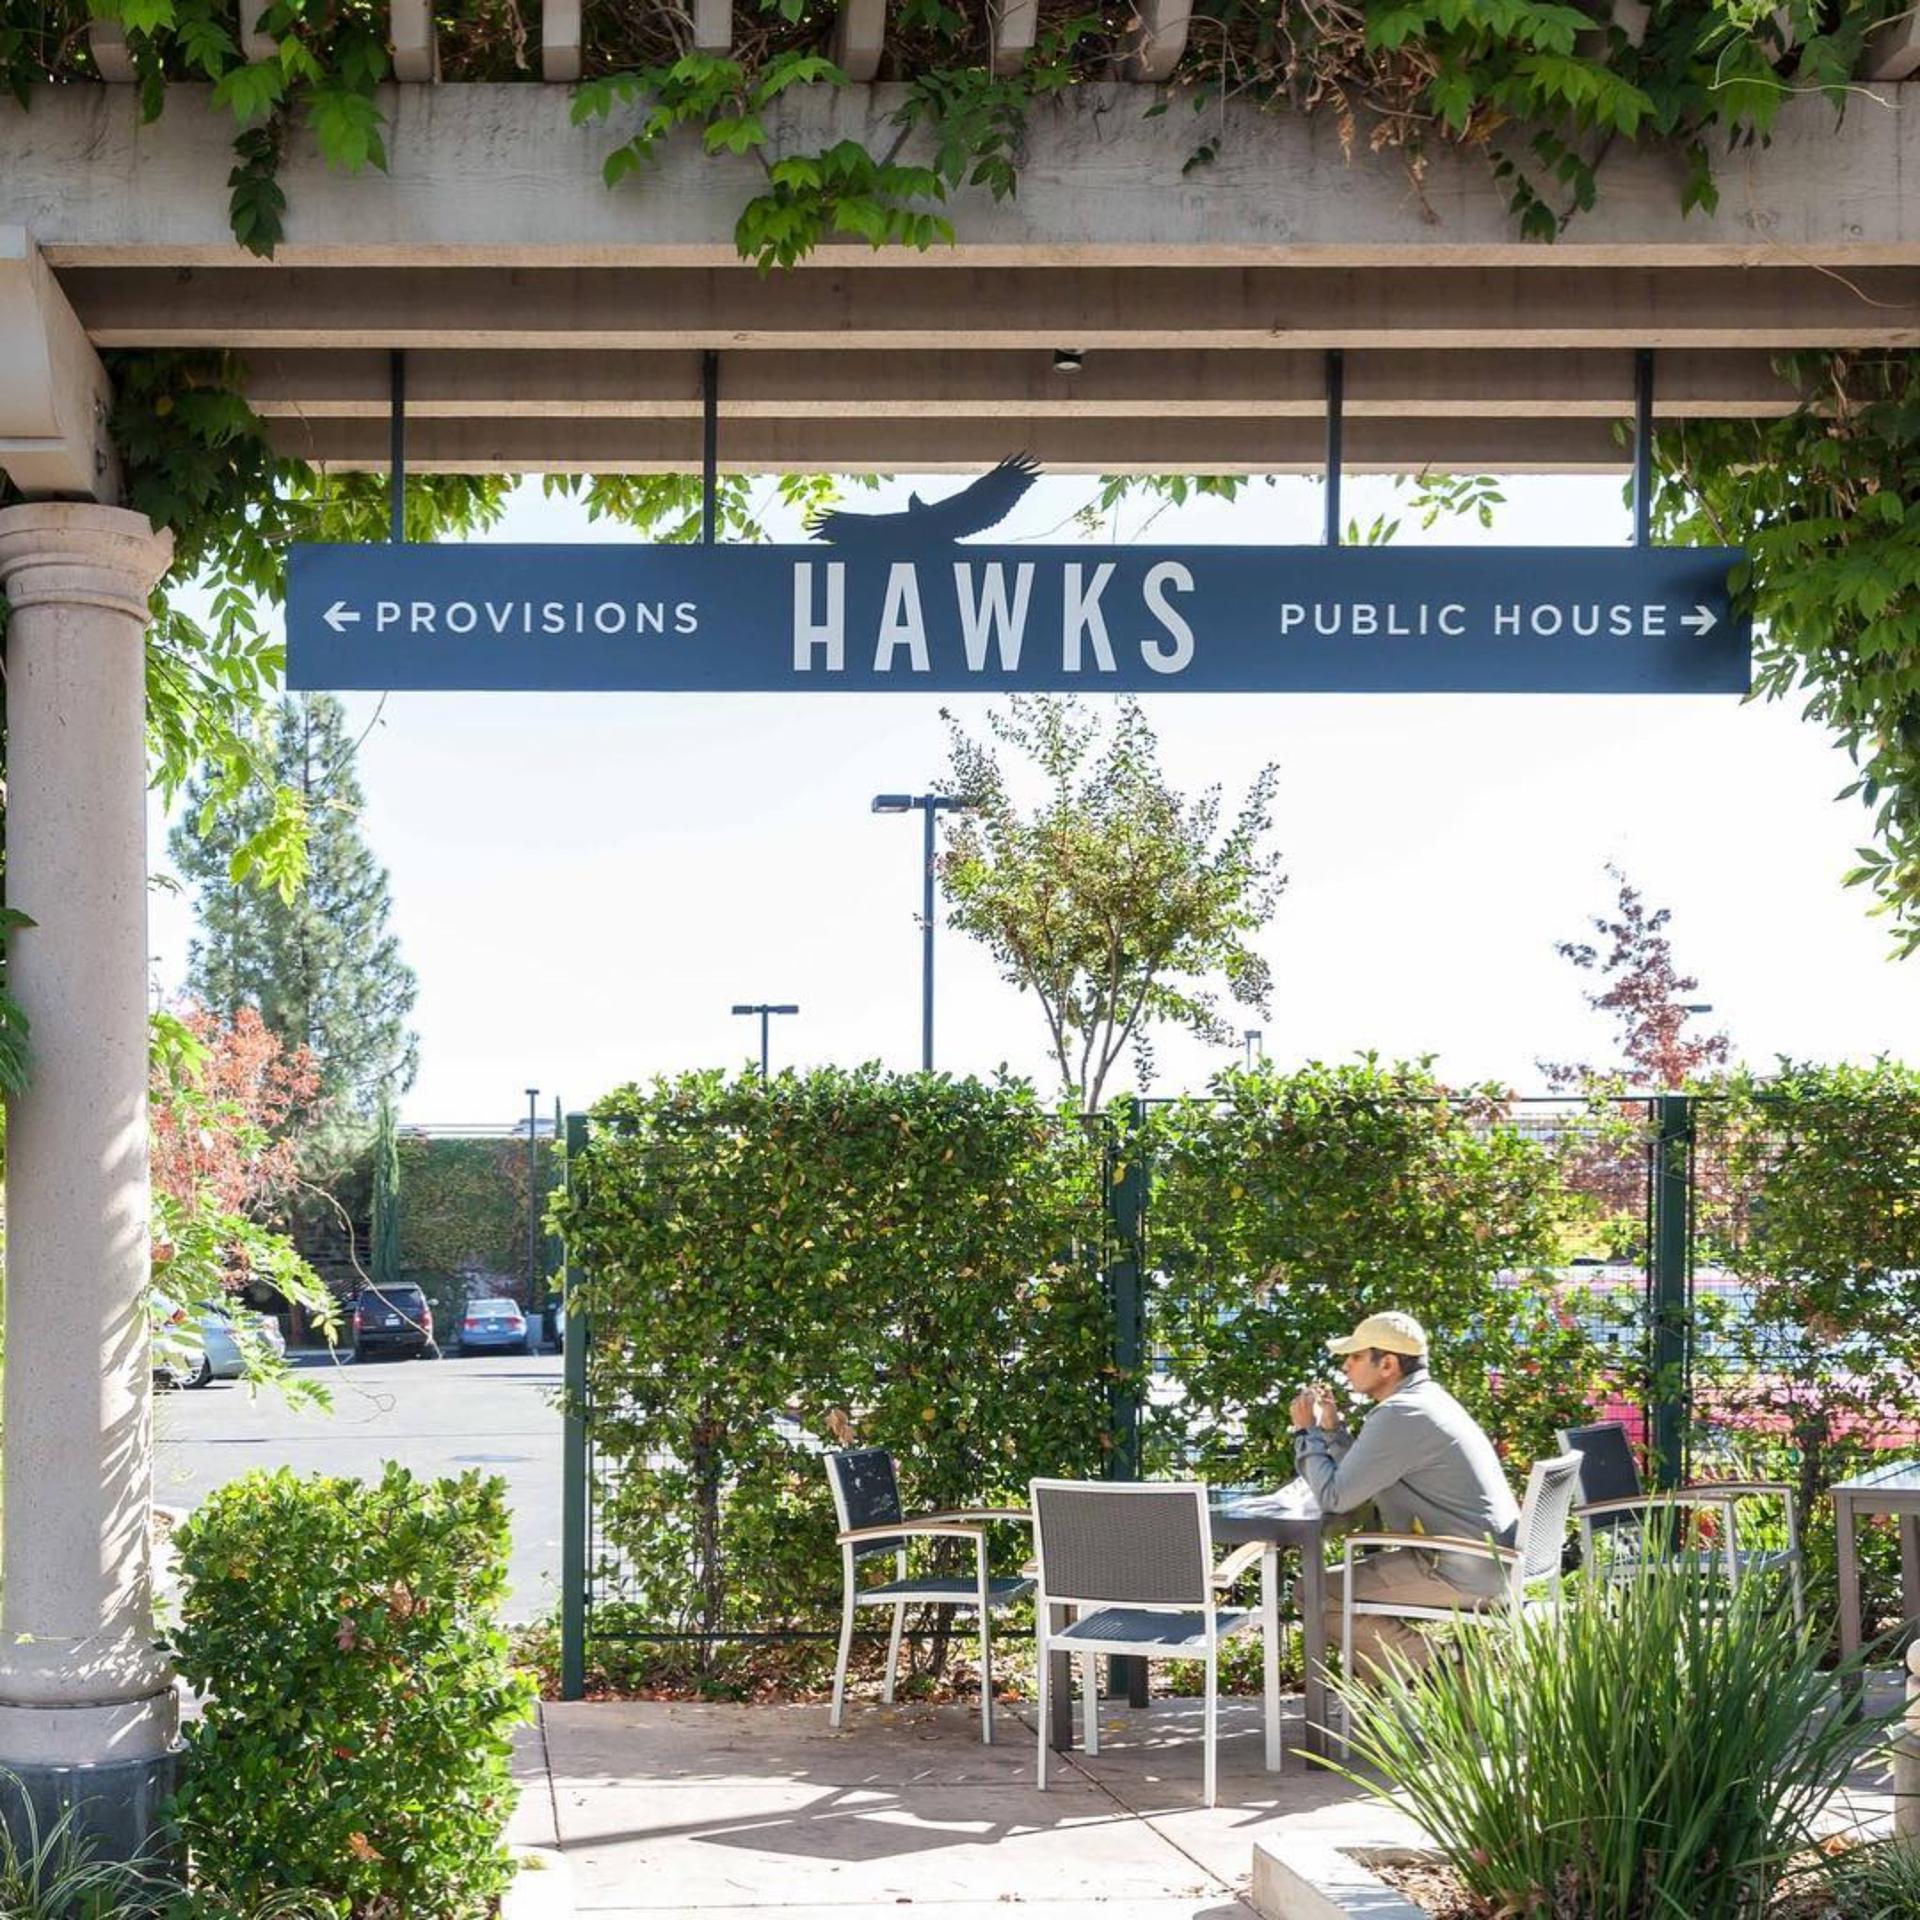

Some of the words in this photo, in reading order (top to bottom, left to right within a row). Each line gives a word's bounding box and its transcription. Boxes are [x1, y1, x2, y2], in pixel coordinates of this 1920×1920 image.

[375, 601, 698, 633] PROVISIONS
[793, 561, 1194, 674] HAWKS
[1280, 603, 1467, 635] PUBLIC
[1494, 604, 1667, 636] HOUSE
